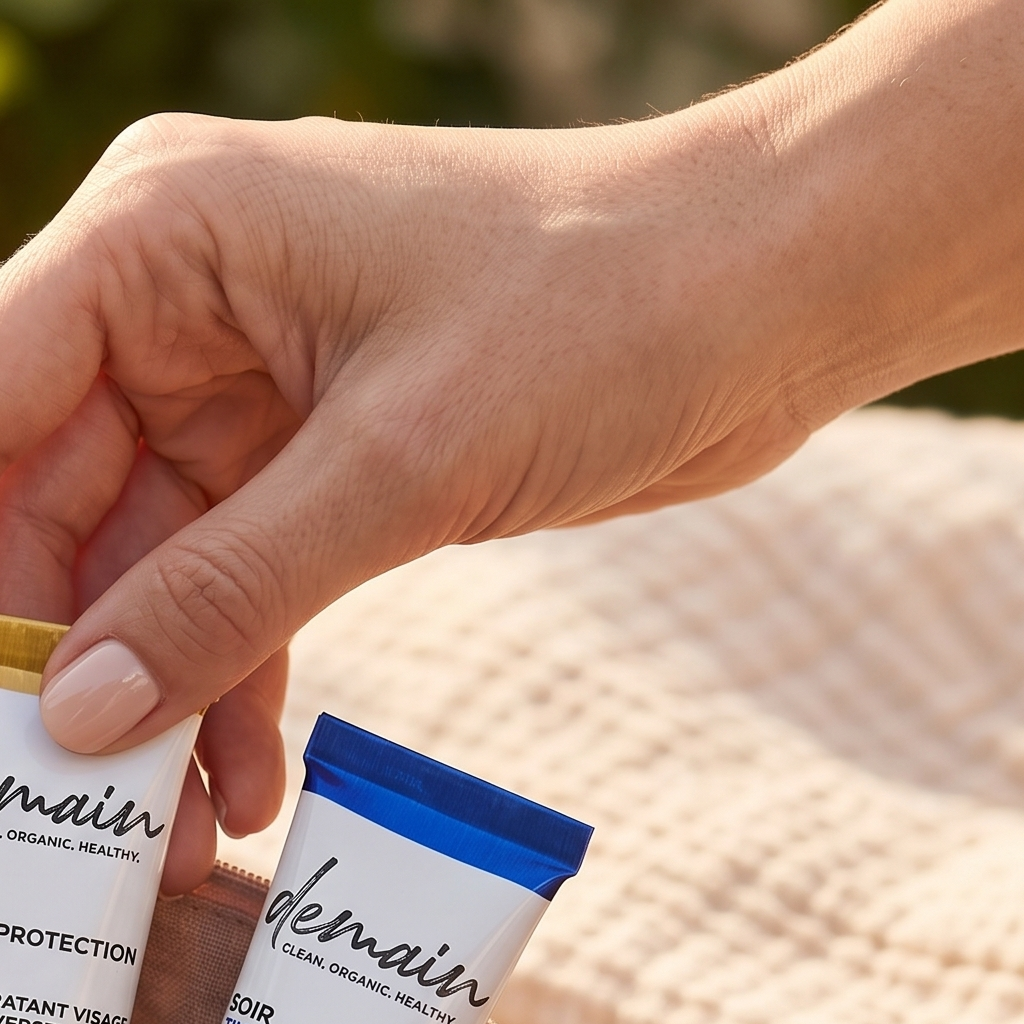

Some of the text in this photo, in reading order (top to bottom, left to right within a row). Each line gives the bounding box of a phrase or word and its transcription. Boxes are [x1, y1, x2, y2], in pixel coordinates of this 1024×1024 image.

[7, 832, 74, 850] ORGANIC.
[79, 842, 139, 863] HEALTHY.
[265, 857, 490, 1008] demain
[283, 943, 324, 969] CLEAN.
[329, 963, 391, 998] ORGANIC.
[229, 994, 274, 1024] SOIR
